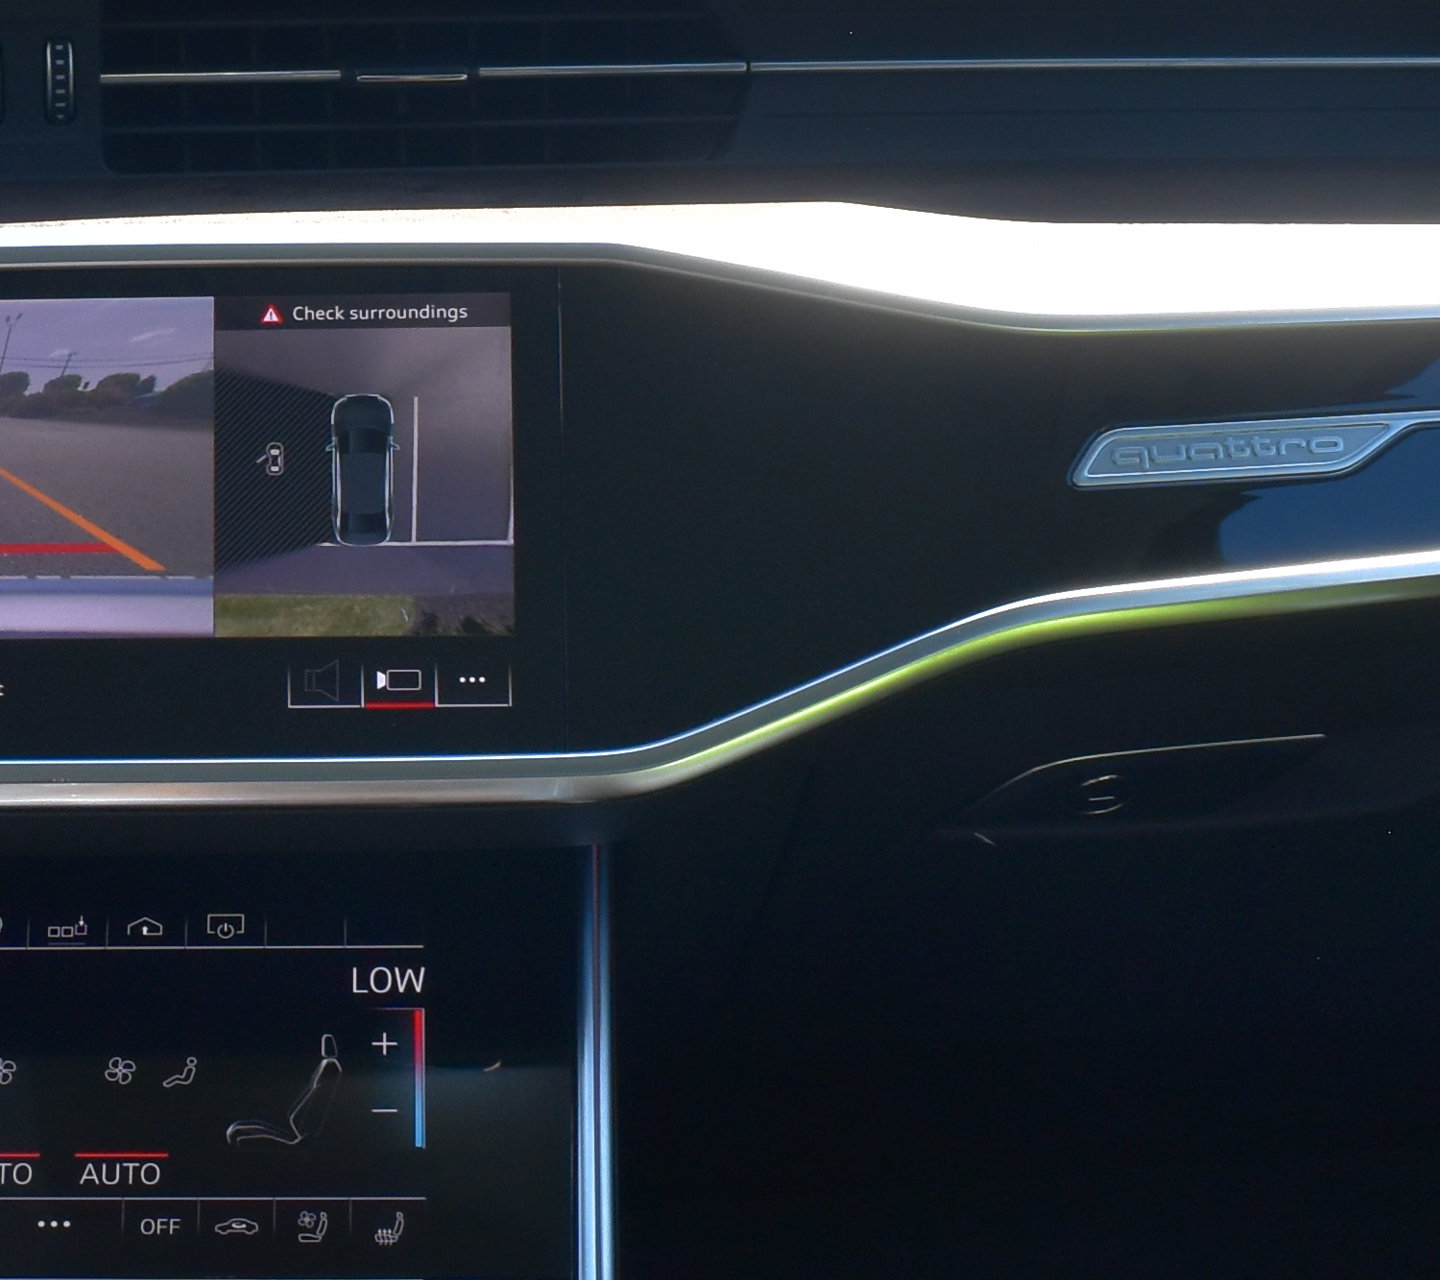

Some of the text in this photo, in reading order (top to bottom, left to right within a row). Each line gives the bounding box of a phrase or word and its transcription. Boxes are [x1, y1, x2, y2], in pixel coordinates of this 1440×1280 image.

[291, 302, 469, 327] Check surroundings
[1111, 434, 1345, 469] quattro
[351, 967, 426, 995] LOW
[79, 1162, 162, 1186] AUTO
[139, 1216, 182, 1237] OFF
